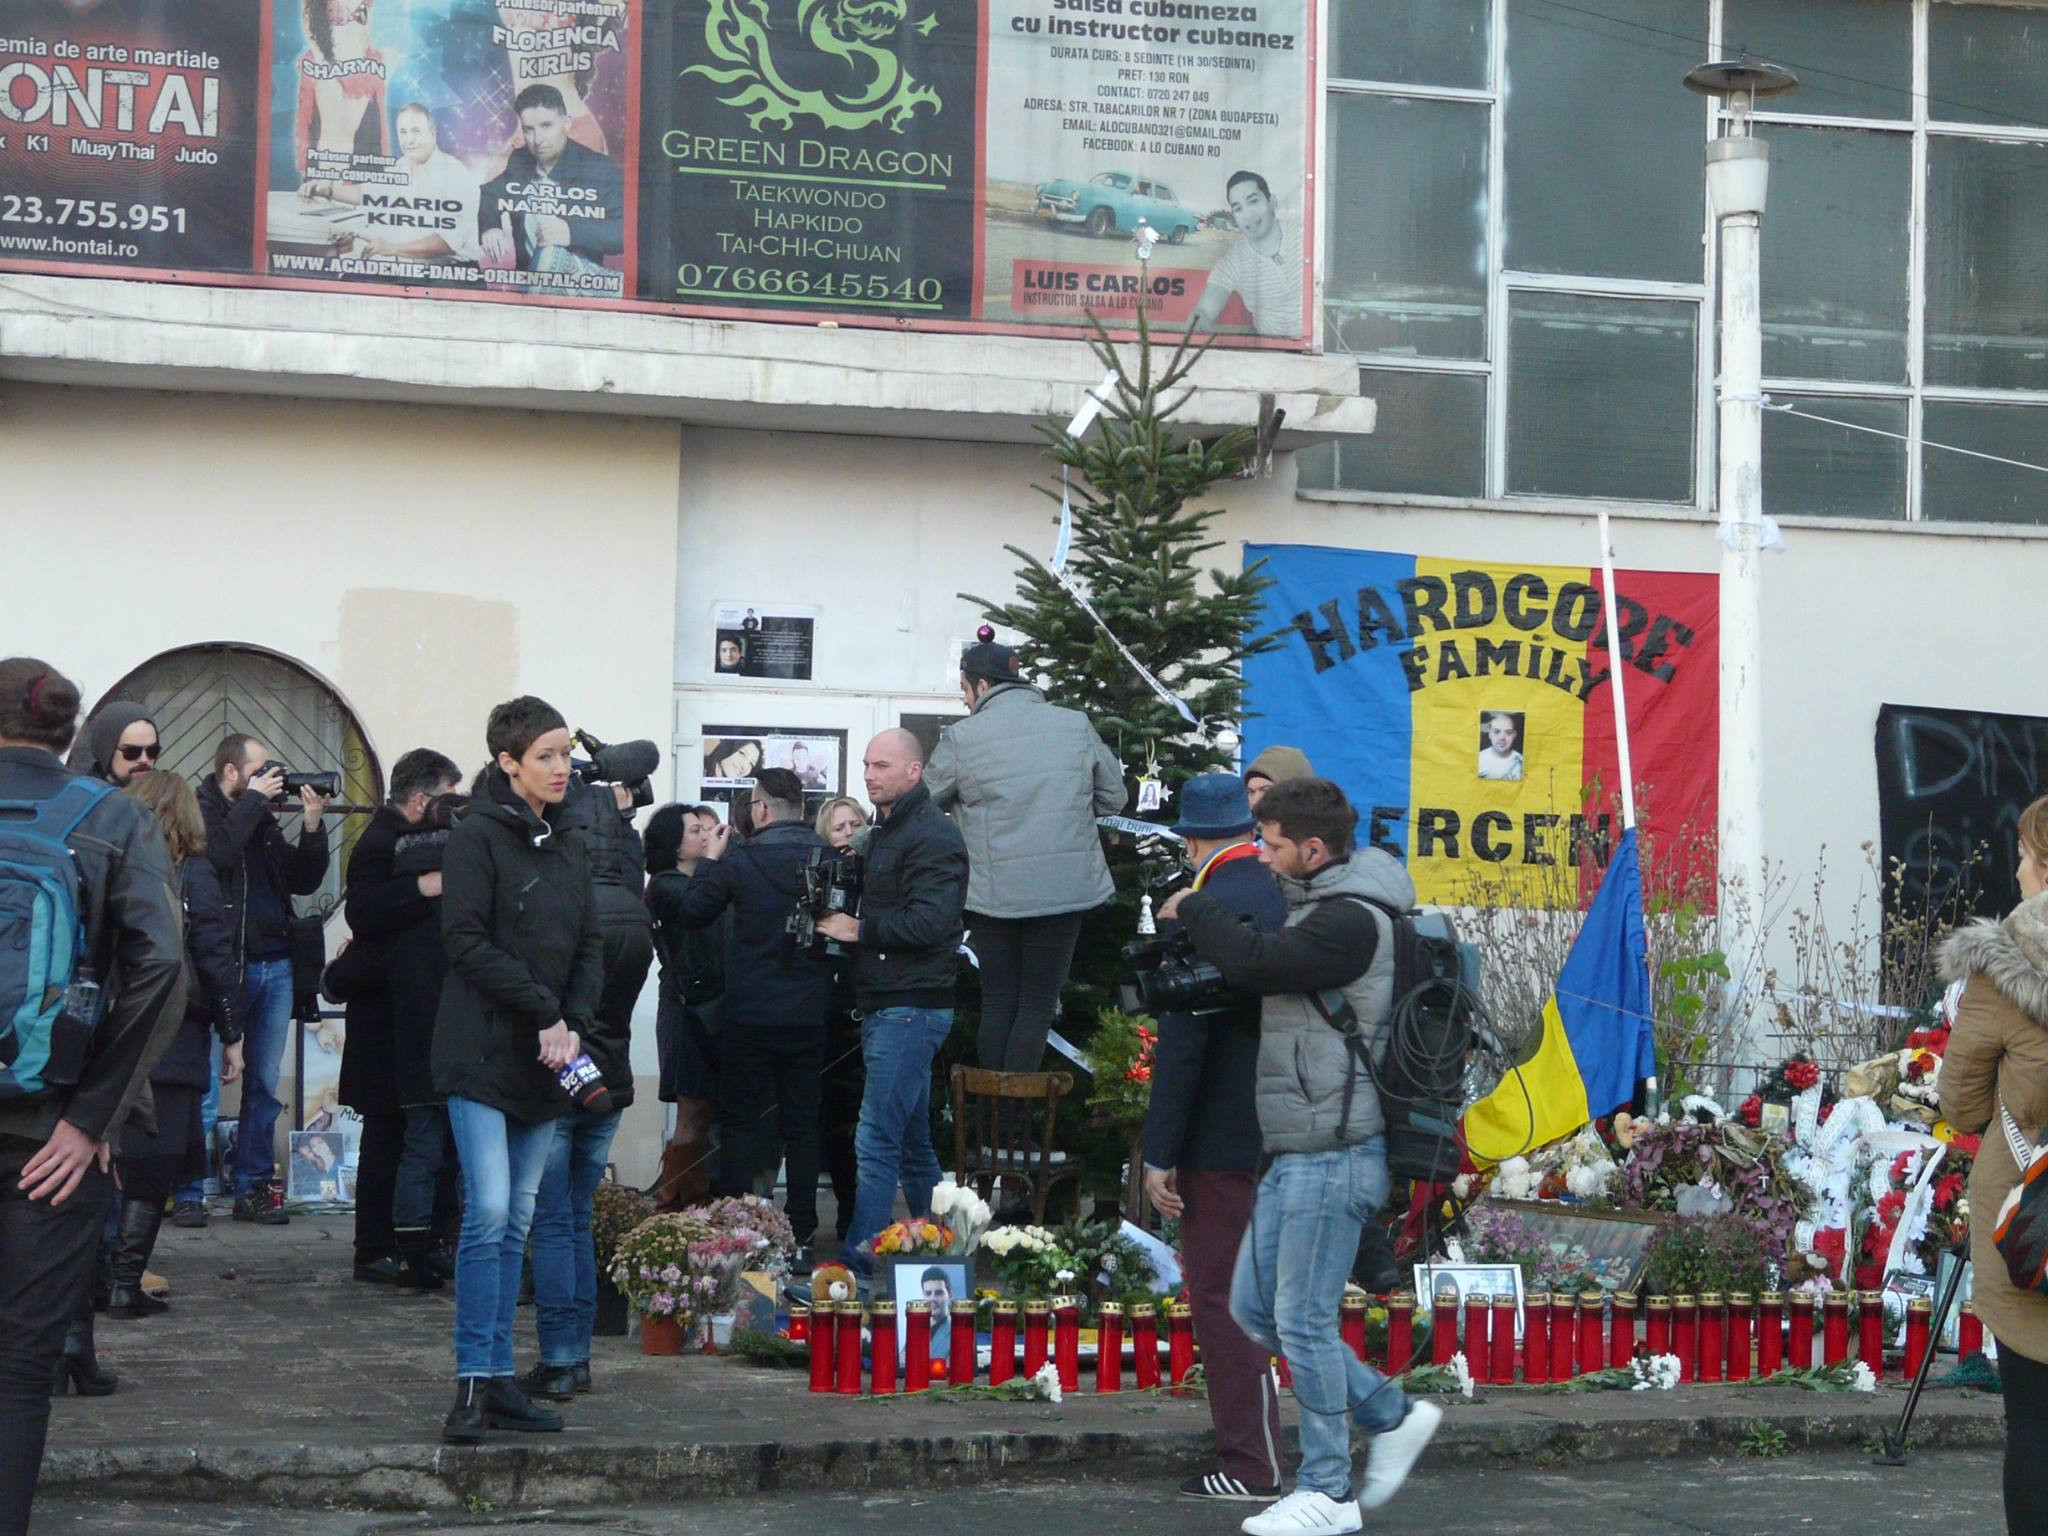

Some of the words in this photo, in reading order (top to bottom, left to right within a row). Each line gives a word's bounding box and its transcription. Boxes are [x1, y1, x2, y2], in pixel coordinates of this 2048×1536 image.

[1130, 0, 1257, 22] cubaneza
[493, 25, 620, 52] FLORENCIA
[1011, 16, 1041, 34] cu
[1048, 15, 1180, 43] instructor
[1187, 28, 1294, 50] cubanez
[53, 40, 80, 58] de
[86, 44, 128, 62] arte
[134, 49, 220, 70] martiale
[520, 52, 592, 78] KIRLIS
[1051, 46, 1089, 60] DURATA
[1092, 48, 1122, 63] CURS:
[1134, 52, 1174, 66] SEDINTE
[302, 59, 385, 80] SHARYN
[1149, 71, 1166, 83] 130
[1169, 72, 1190, 84] RON
[1097, 85, 1145, 100] CONTACT:
[1147, 89, 1170, 100] 0720
[1173, 90, 1190, 102] 247
[1024, 98, 1066, 112] ADRESA:
[1069, 101, 1091, 113] STR.
[1094, 102, 1160, 117] TABACARILOR
[1163, 106, 1177, 119] NR
[1180, 108, 1186, 119] 7
[1188, 108, 1217, 122] (ZONA
[1220, 110, 1279, 127] BUDAPESTA)
[1063, 118, 1097, 132] EMAIL:
[26, 134, 49, 151] K1
[175, 147, 218, 165] Judo
[1083, 137, 1138, 152] FACEBOOK:
[1140, 141, 1147, 153] A
[1150, 142, 1162, 154] LO
[1165, 142, 1204, 157] CUBANO
[1207, 145, 1221, 157] RO
[505, 182, 599, 202] CARLOS
[2, 194, 186, 234] 23.755.951
[362, 194, 463, 214] MARIO
[497, 199, 606, 220] NAHMANI
[367, 212, 457, 231] KIRLIS
[0, 235, 138, 257] www.hontai.ro
[273, 254, 619, 291] WWW.ACADEMIE-DANS-ORIENTAL.COM
[677, 263, 943, 302] 0766645540
[1024, 269, 1079, 291] LUIS
[1023, 291, 1077, 307] INSTRUCTOR
[1080, 294, 1105, 309] SALSA
[1293, 570, 1695, 684] HARDCORE
